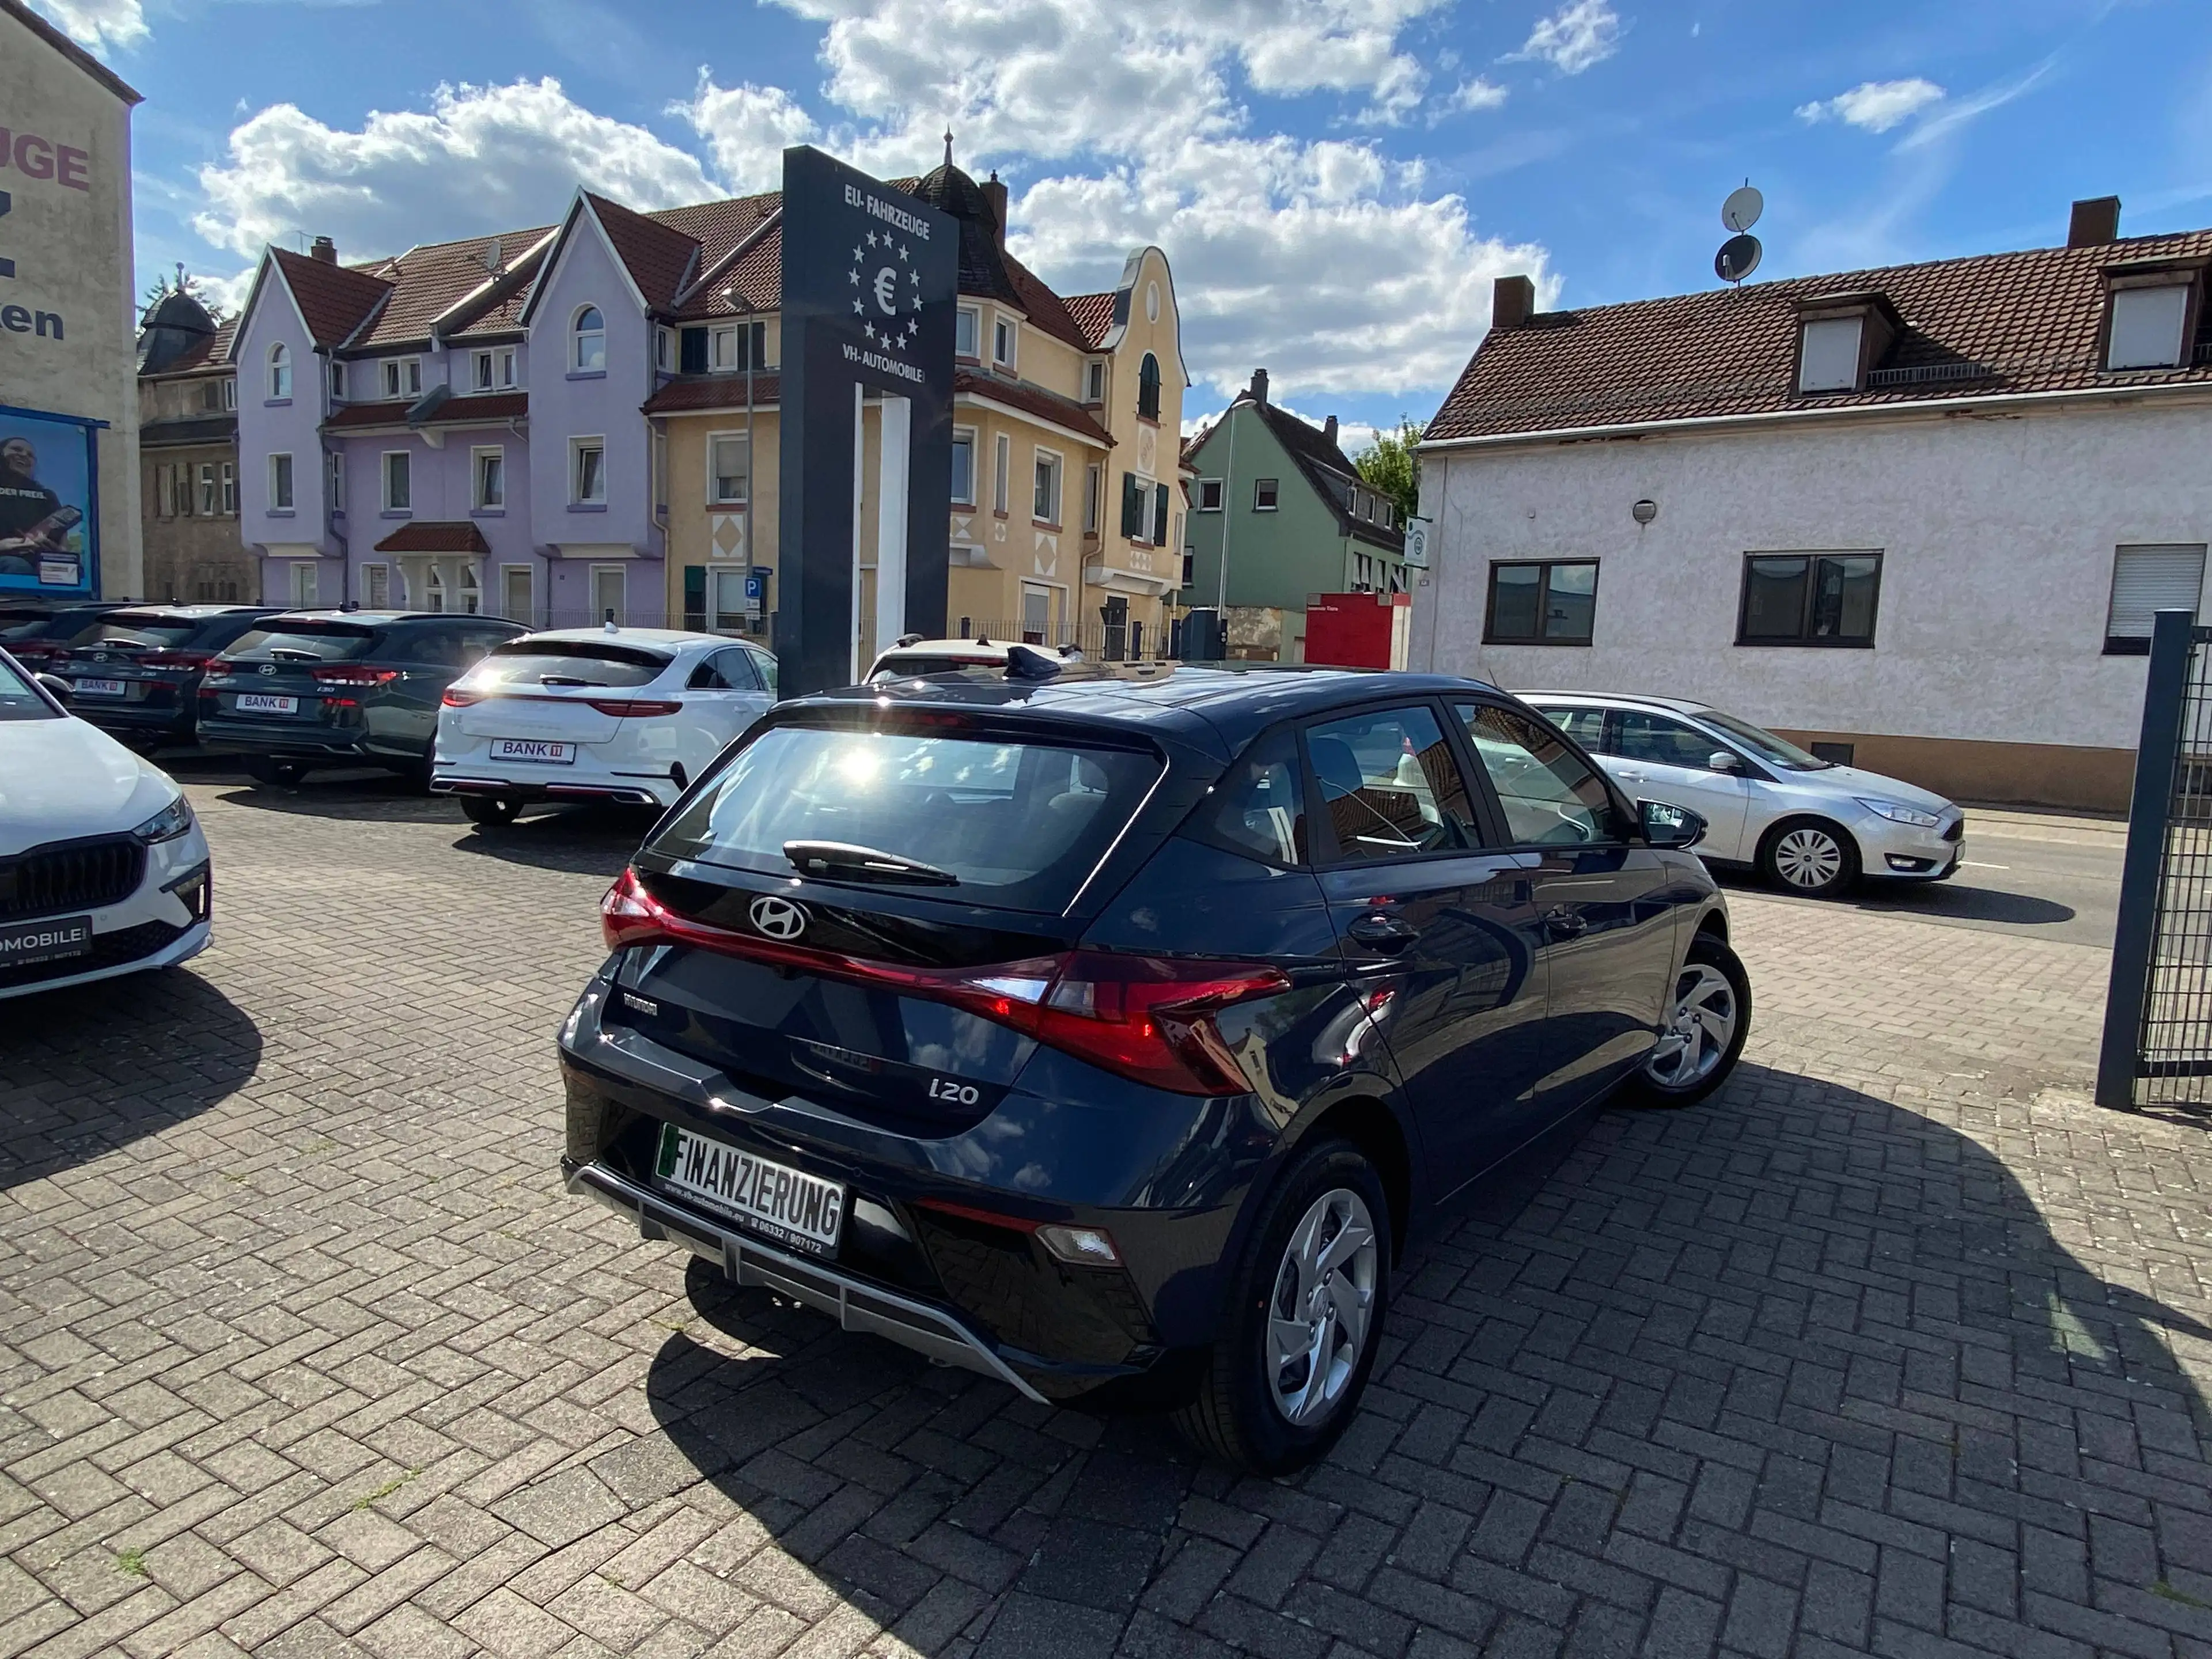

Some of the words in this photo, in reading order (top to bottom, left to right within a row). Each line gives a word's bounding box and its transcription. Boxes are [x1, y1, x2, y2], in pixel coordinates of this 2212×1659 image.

[0, 127, 89, 192] GE
[845, 184, 865, 208] EU-
[866, 194, 930, 241] FAHRZEUGE
[0, 305, 63, 340] en
[843, 343, 862, 361] VH-
[862, 351, 923, 384] AUTOMOBILE
[748, 580, 756, 595] P
[81, 680, 109, 690] BANK
[245, 696, 276, 708] BANK
[503, 742, 548, 755] BANK
[0, 928, 81, 952] MOBILE
[672, 1132, 840, 1236] FINANZIERUNG
[759, 1220, 784, 1239] 06332
